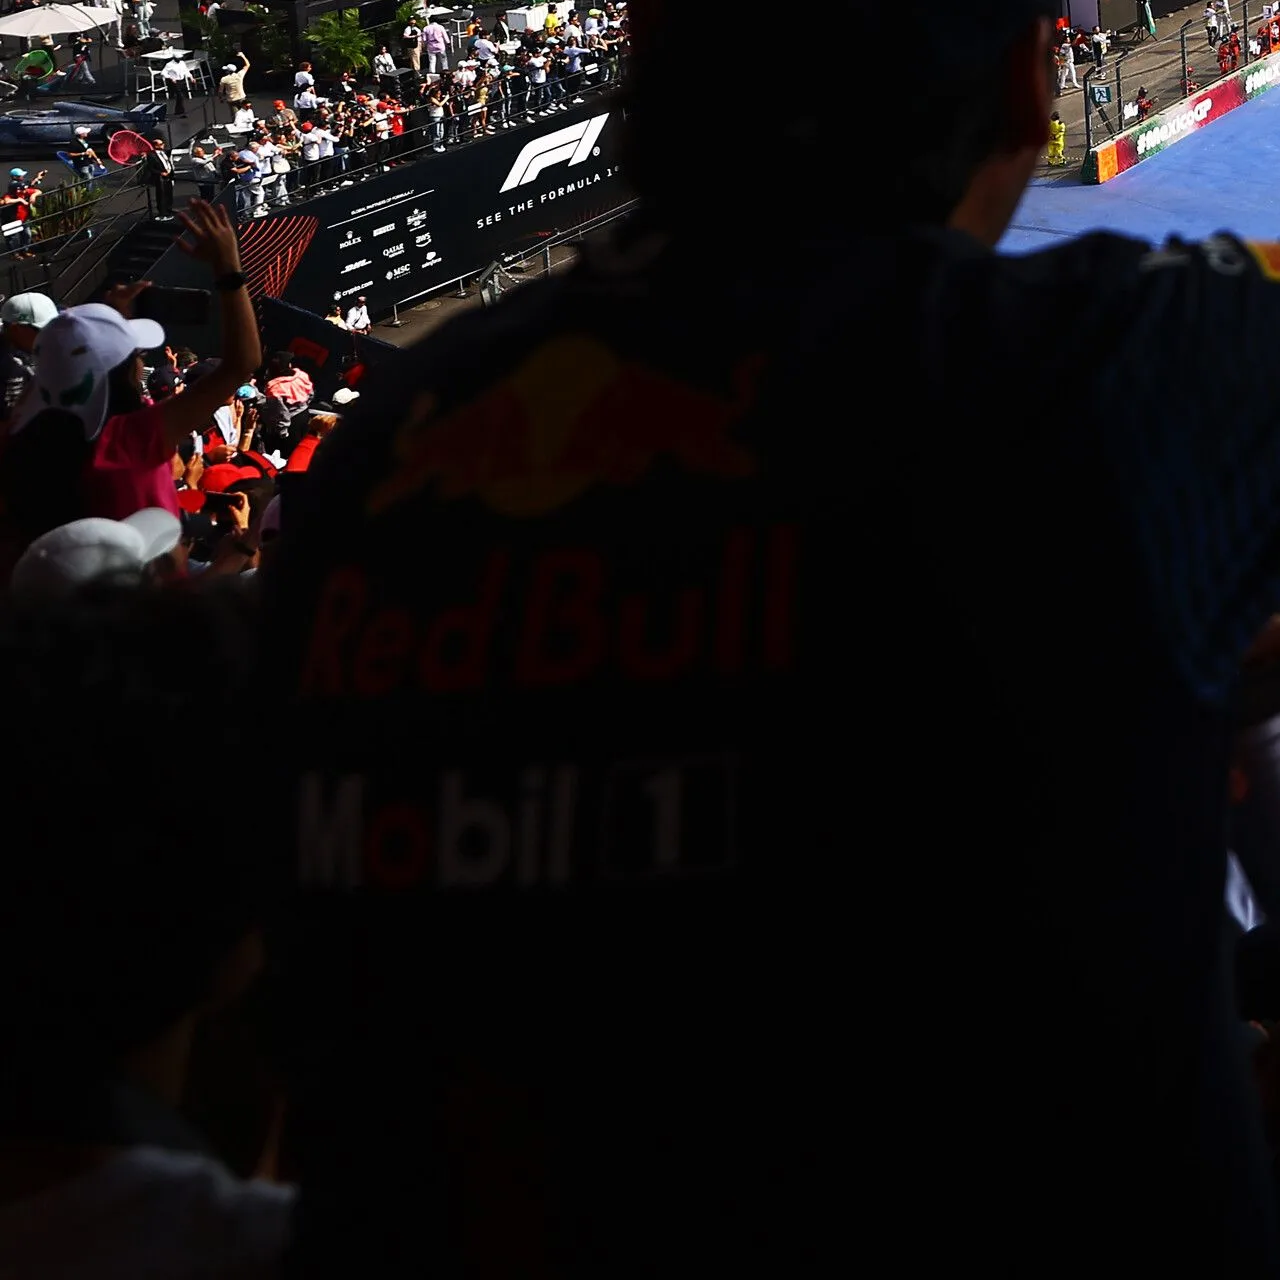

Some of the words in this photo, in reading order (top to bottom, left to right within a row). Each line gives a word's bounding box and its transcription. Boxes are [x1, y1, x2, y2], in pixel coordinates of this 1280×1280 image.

[476, 212, 502, 229] SEE
[508, 199, 534, 216] THE
[540, 173, 601, 204] FORMULA
[383, 243, 404, 257] QATAR
[393, 264, 411, 276] MSC
[342, 280, 374, 297] crypto.com
[299, 547, 511, 703] Red
[514, 522, 800, 689] Bull
[297, 762, 579, 893] Mobil
